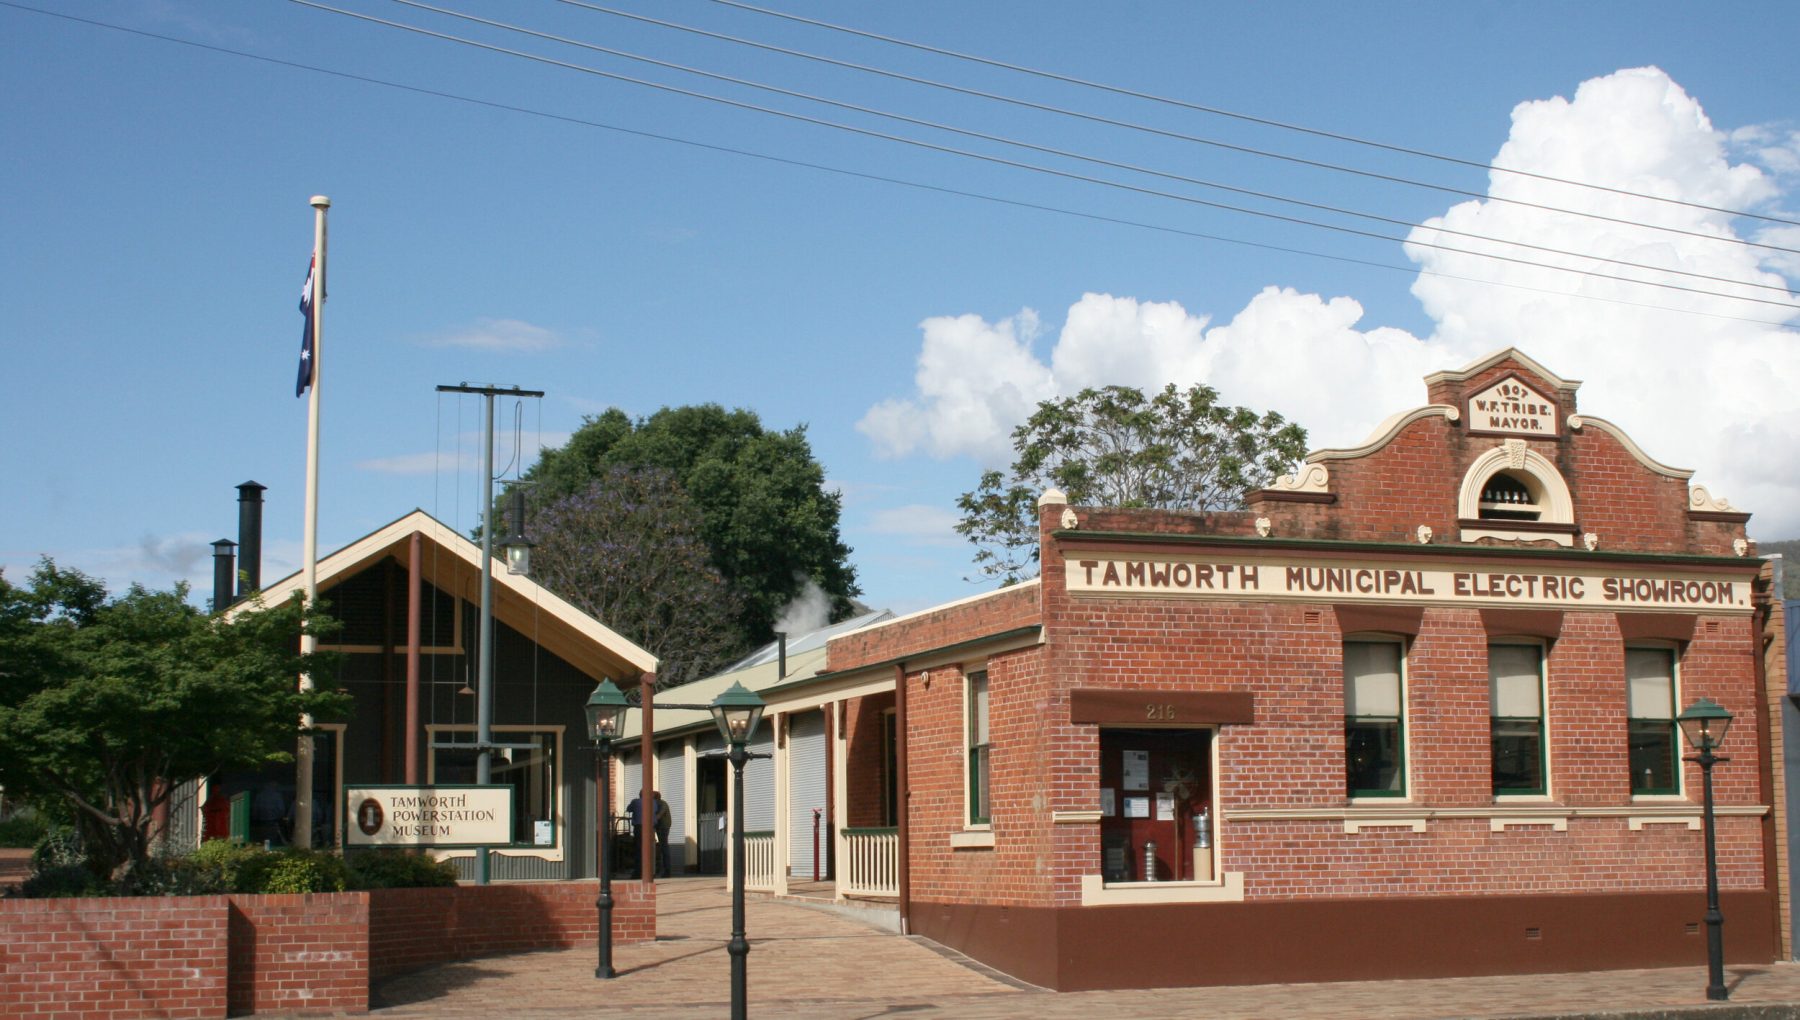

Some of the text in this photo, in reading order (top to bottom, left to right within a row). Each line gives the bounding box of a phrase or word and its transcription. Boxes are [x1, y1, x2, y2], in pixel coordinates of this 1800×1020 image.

[1489, 416, 1542, 430] MAYOR.
[1079, 560, 1744, 605] TAMWORTH MUNICIPAL ELECTRIC SHOWROOM.
[1146, 704, 1175, 720] 216
[390, 794, 466, 809] TAMWORTH
[392, 808, 495, 822] POWERSTATION
[392, 824, 450, 837] MUSEUM
